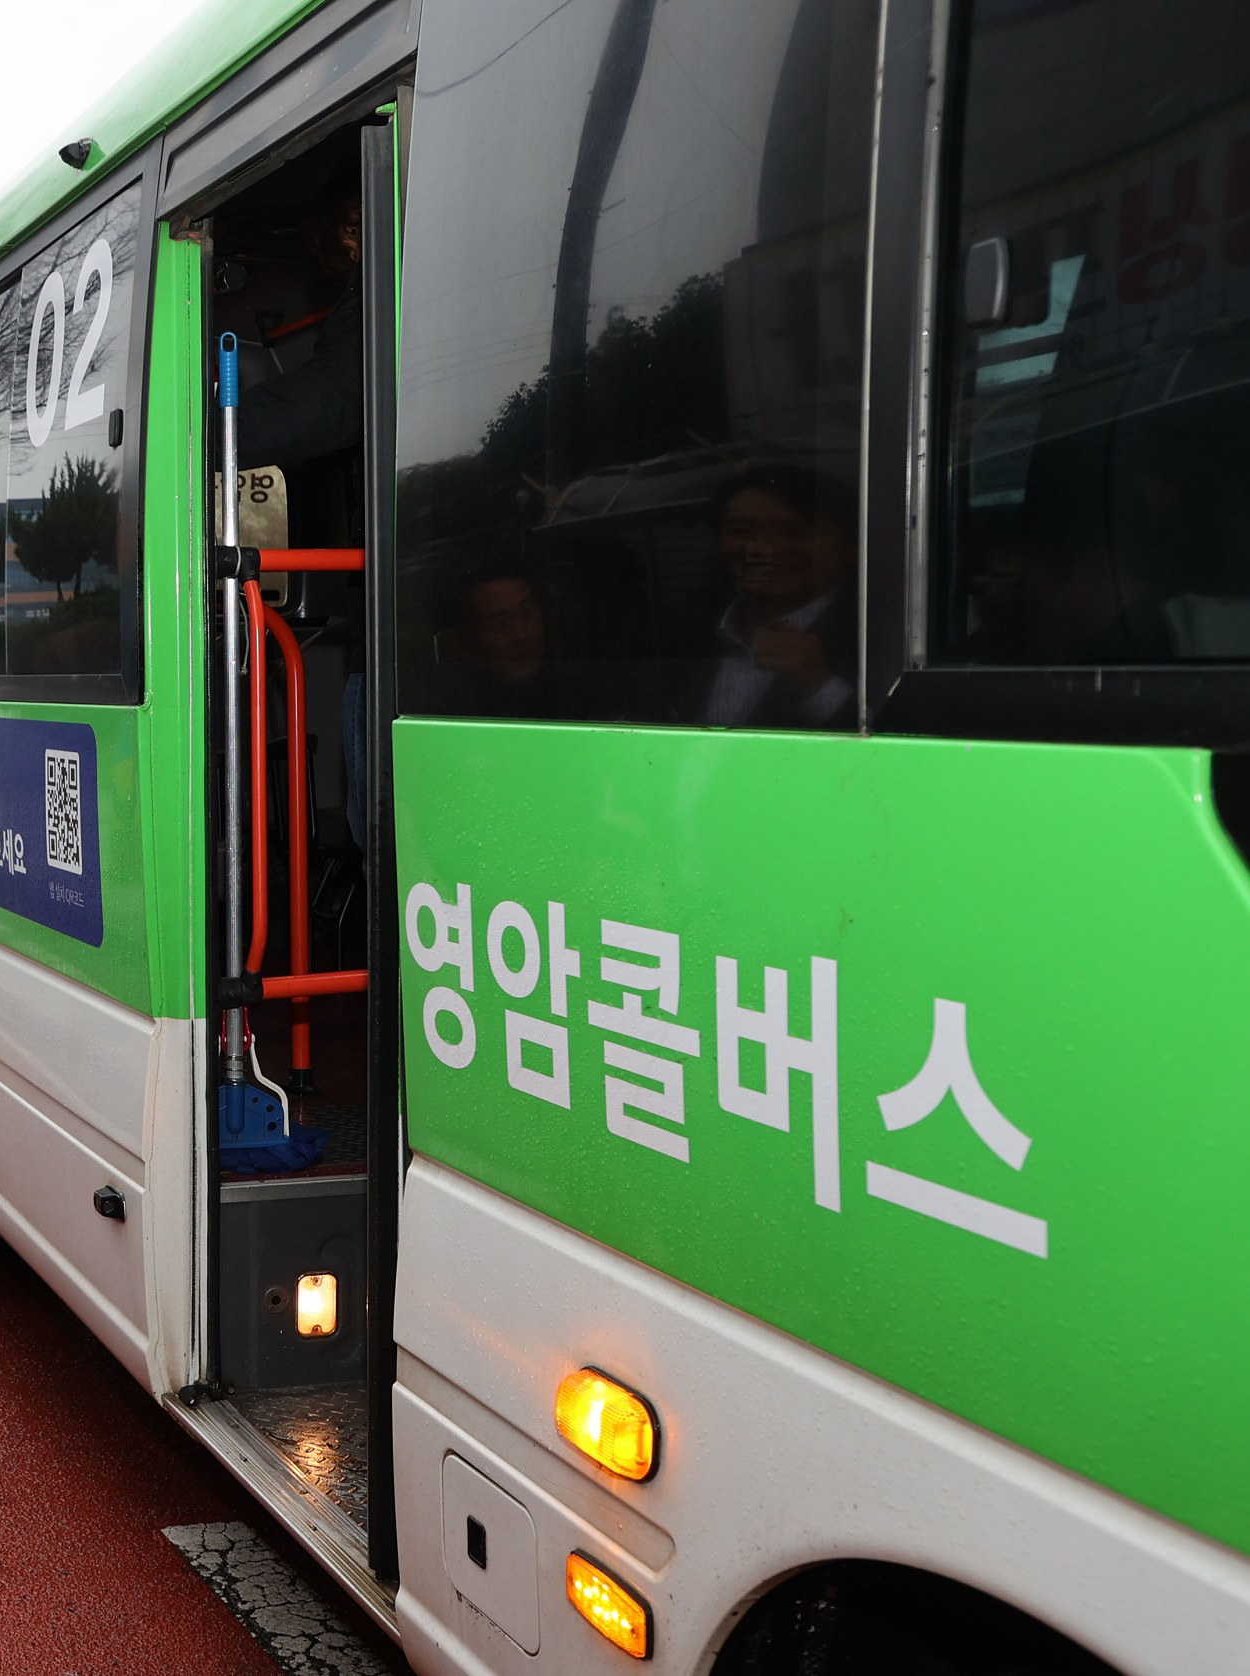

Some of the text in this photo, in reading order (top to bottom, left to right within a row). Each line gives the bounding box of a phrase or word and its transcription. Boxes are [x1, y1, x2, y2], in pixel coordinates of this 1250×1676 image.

[26, 238, 113, 447] 02
[65, 888, 85, 908] QR코드
[405, 881, 1048, 1260] 영암콜버스
